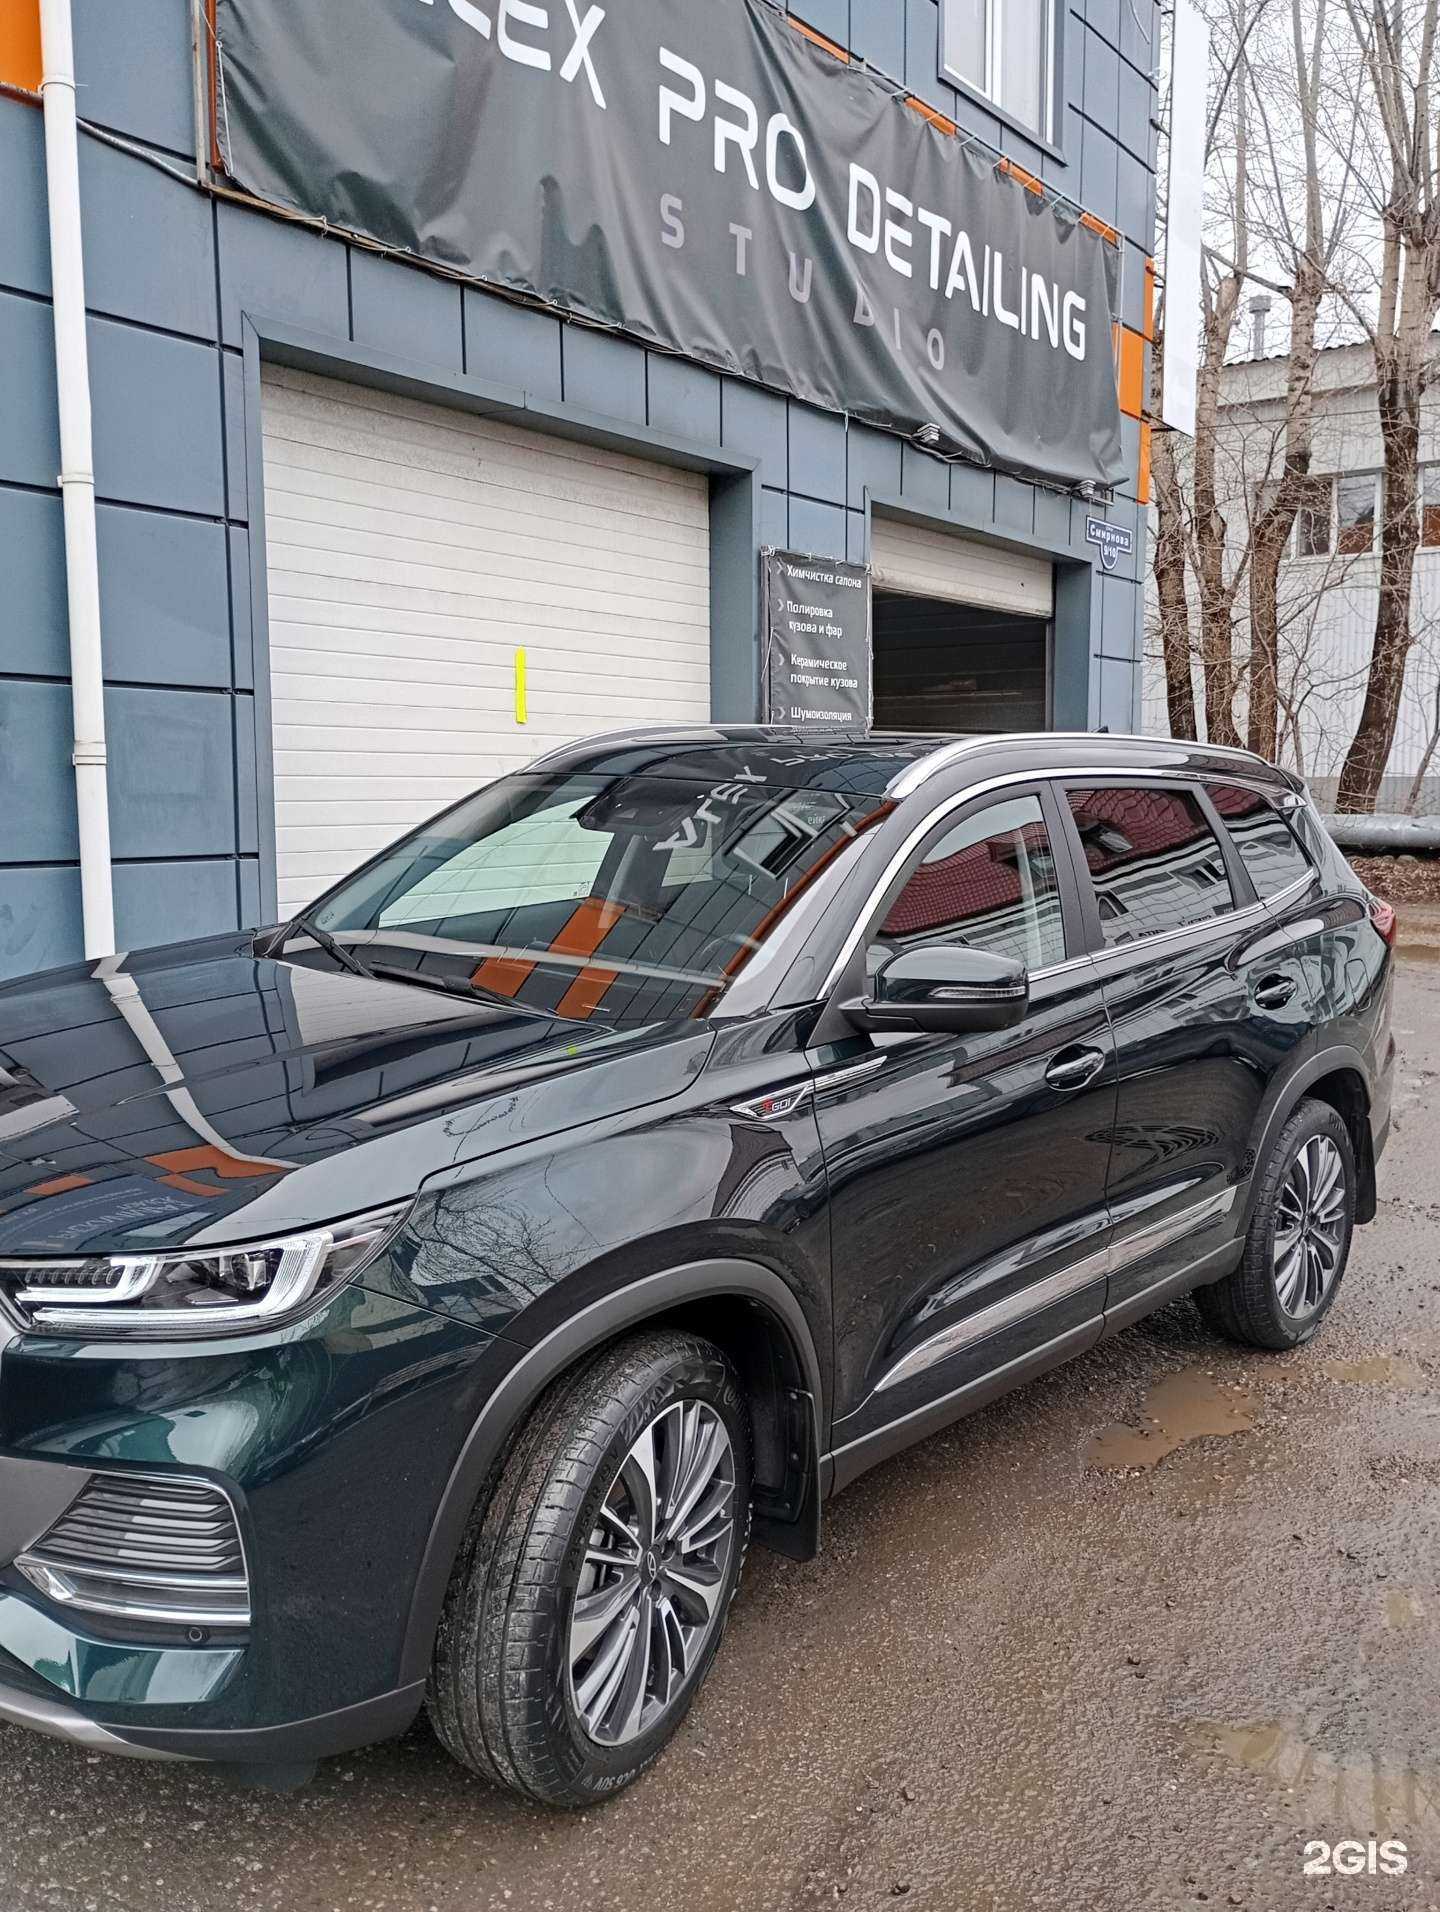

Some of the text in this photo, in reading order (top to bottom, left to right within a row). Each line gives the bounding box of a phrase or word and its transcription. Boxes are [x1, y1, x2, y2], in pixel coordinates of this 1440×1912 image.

[658, 47, 816, 210] PRO
[847, 163, 1087, 360] DETAILING
[660, 193, 946, 371] STUDIO
[1090, 524, 1129, 546] Смирнова
[787, 564, 862, 588] Химчистка салона
[786, 600, 833, 618] Полировка
[789, 621, 843, 638] кузова и фар
[791, 653, 847, 670] Керамическое
[790, 673, 858, 690] покрытие кузова
[791, 707, 852, 722] Шумоизоляция
